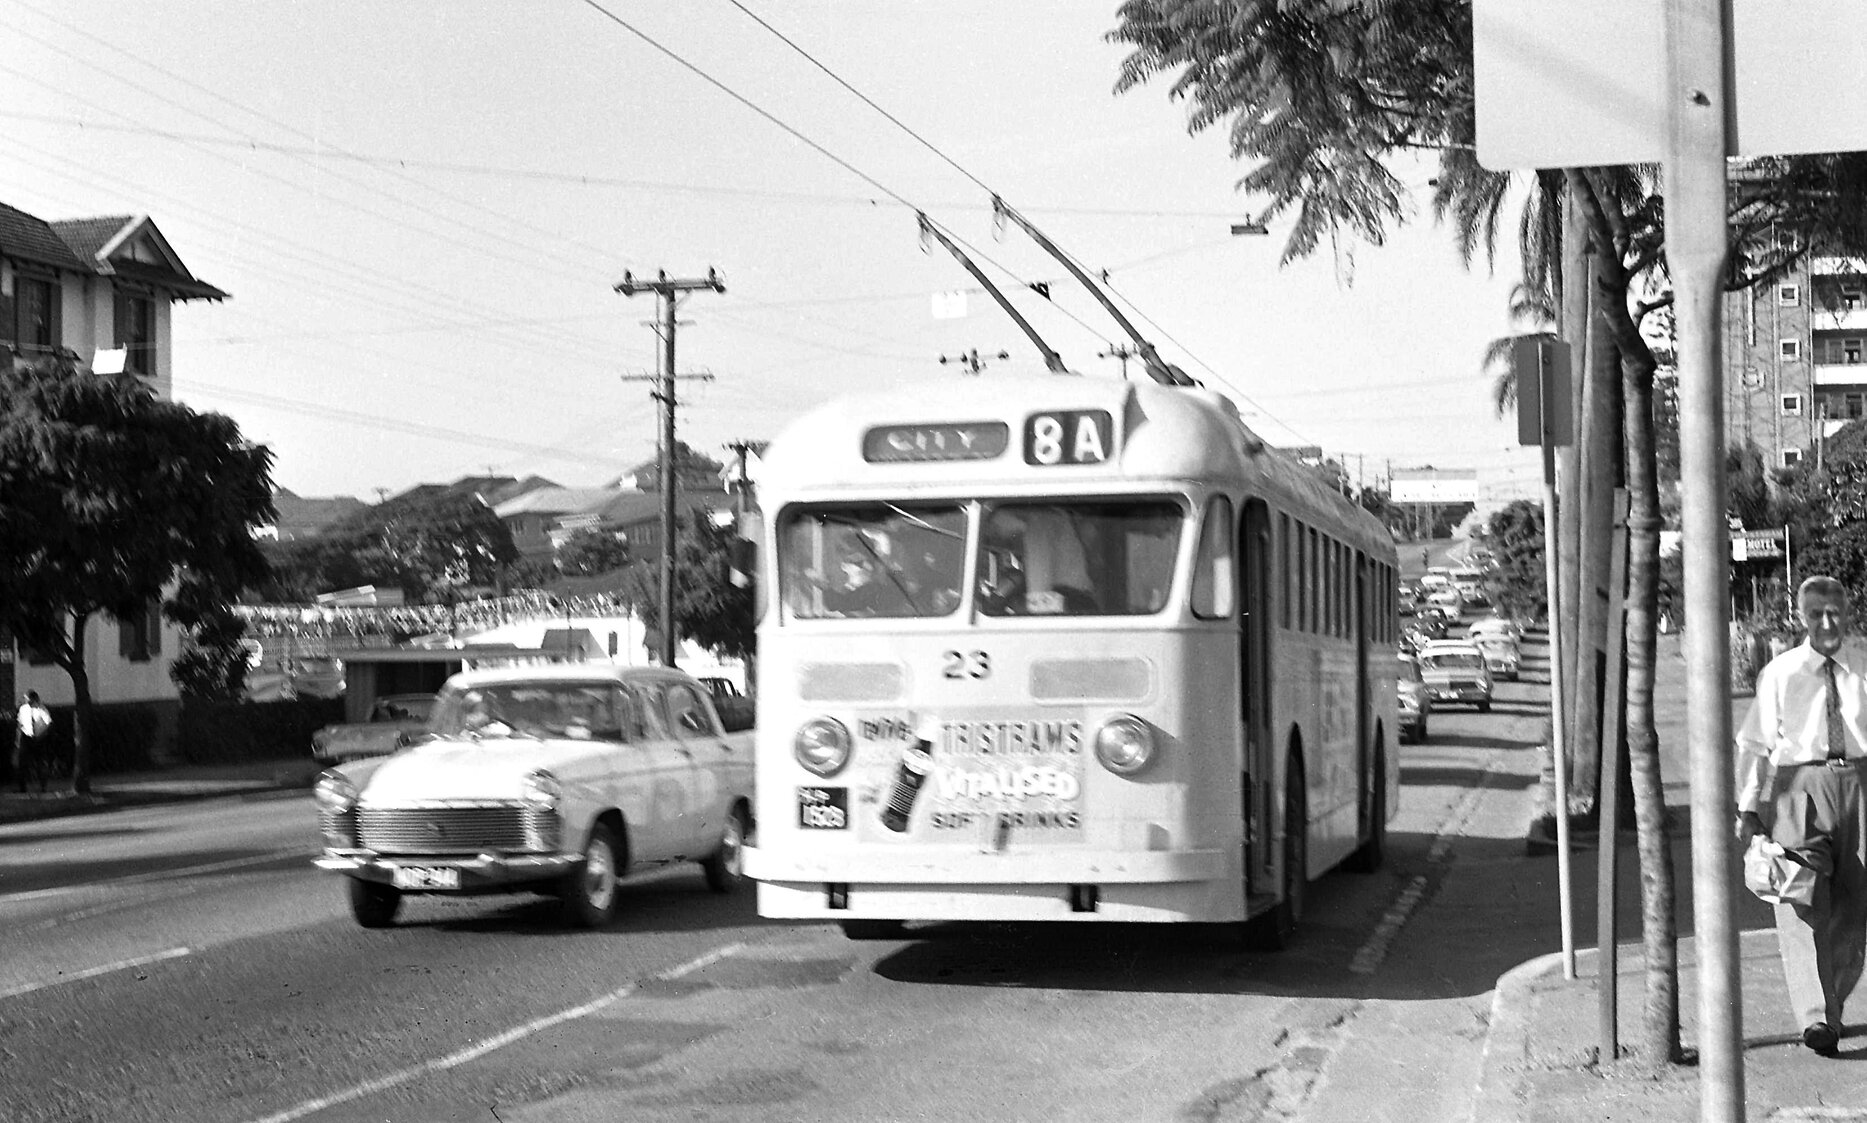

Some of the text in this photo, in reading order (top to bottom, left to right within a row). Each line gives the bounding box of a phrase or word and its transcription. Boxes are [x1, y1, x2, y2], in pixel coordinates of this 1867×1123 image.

[887, 429, 976, 451] CITY
[943, 650, 990, 680] 23
[942, 722, 1082, 753] TRISTRAMS
[936, 766, 1082, 801] VITALISED
[1000, 811, 1081, 829] DRINKS
